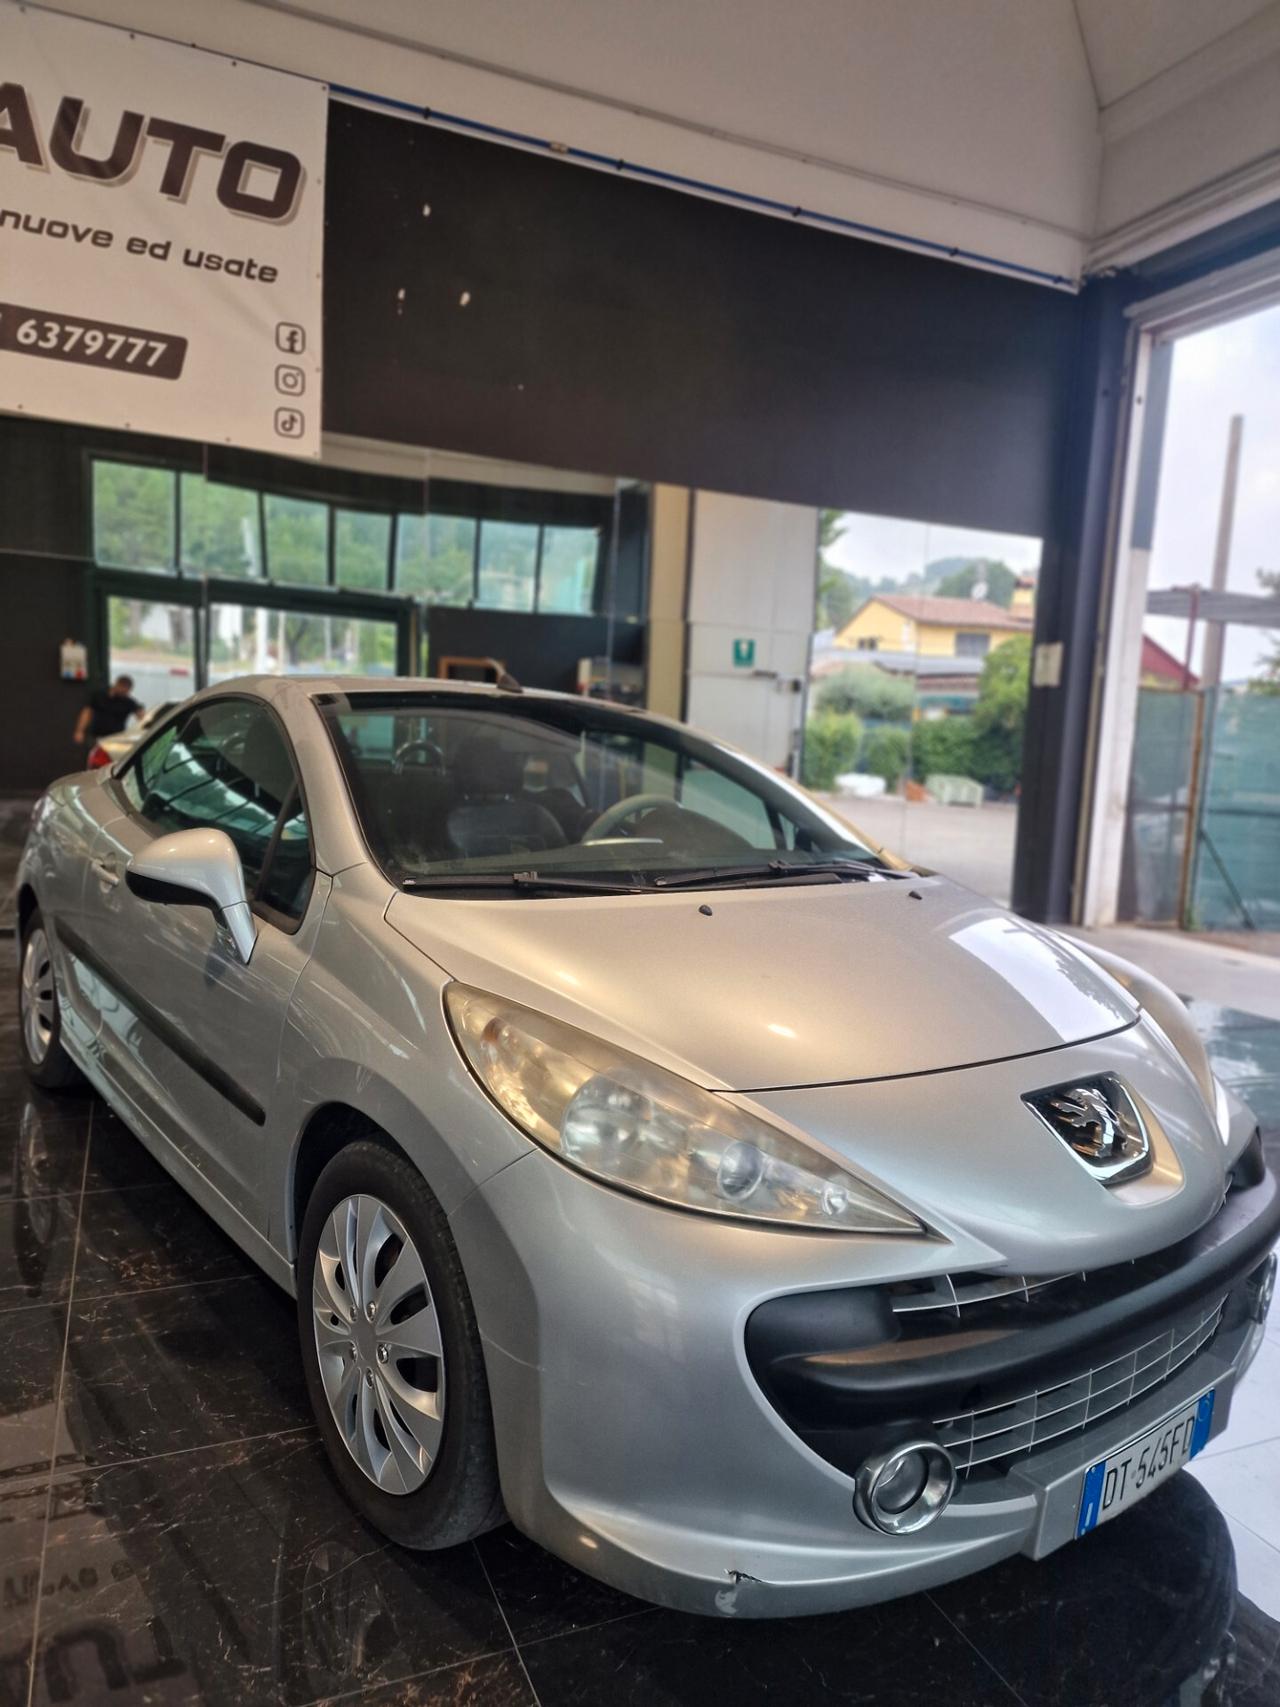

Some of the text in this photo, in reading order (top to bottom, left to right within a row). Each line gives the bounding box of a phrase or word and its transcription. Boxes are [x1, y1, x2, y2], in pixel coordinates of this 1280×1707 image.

[0, 82, 305, 226] AUTO
[0, 208, 278, 284] nuove ed usate
[16, 318, 168, 368] 6379777
